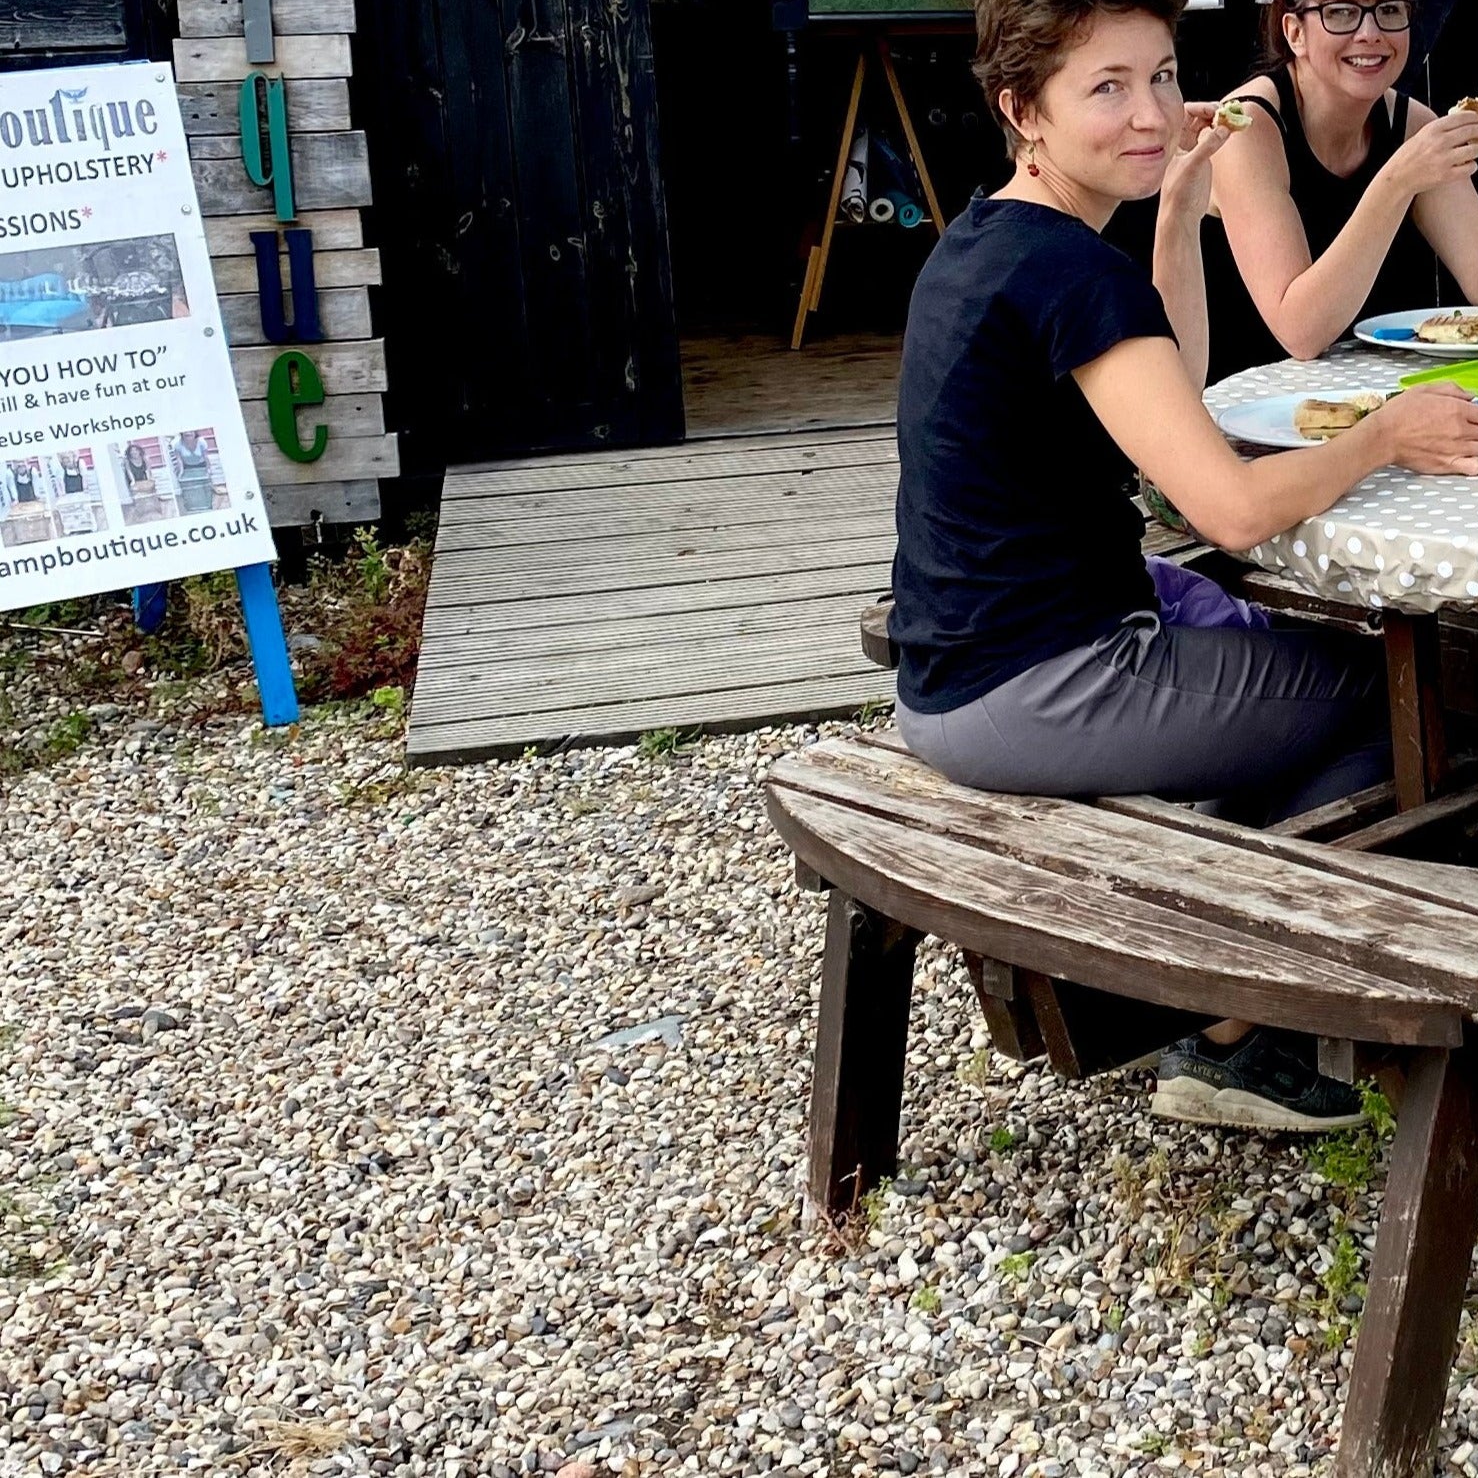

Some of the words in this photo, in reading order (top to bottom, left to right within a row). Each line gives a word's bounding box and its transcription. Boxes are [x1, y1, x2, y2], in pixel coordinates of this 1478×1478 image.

[0, 363, 49, 388] YOU
[57, 354, 118, 380] HOW
[0, 395, 18, 414] ill
[24, 393, 39, 410] &
[45, 389, 91, 407] have
[95, 382, 127, 399] fun
[132, 378, 150, 394] at
[155, 374, 187, 390] our
[0, 429, 45, 448] eUse
[49, 412, 156, 439] Workshops
[0, 512, 259, 578] ampboutique.co.uk
